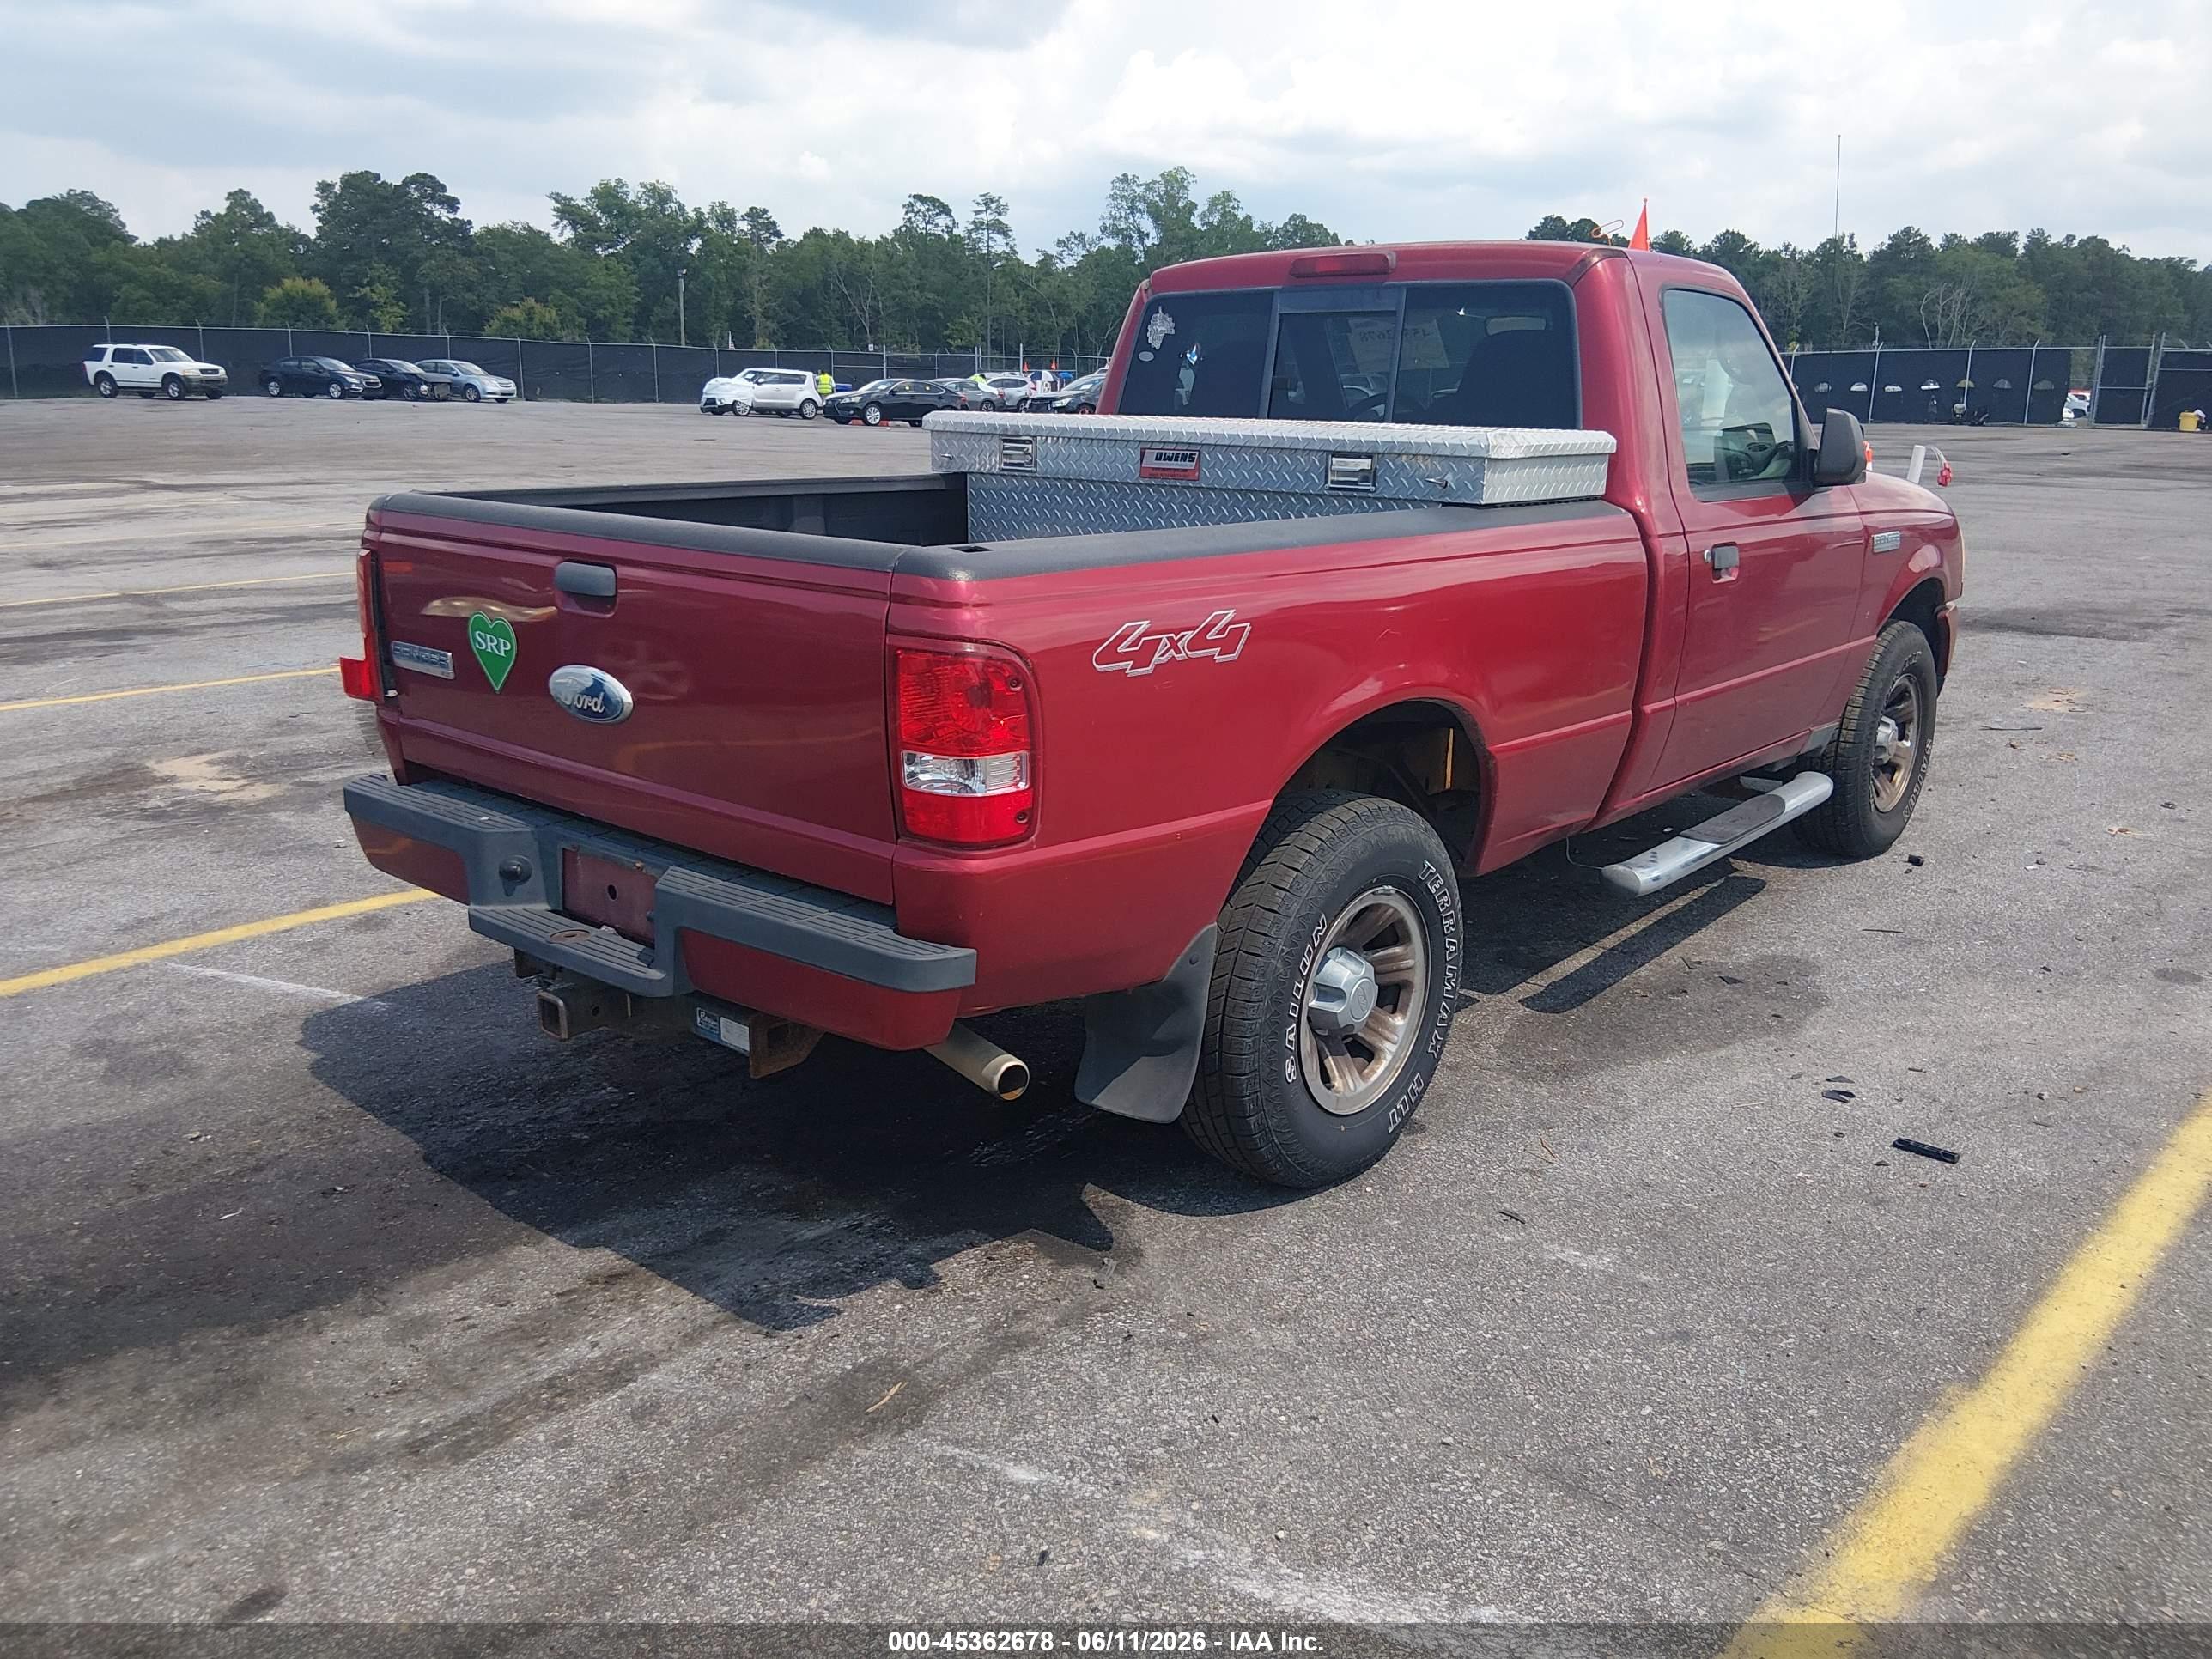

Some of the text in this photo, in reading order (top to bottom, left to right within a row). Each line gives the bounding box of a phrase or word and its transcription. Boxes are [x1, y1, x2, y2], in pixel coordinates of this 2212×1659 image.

[1154, 451, 1197, 463] OWENS
[475, 630, 512, 658] SRP
[1092, 608, 1252, 678] 4x4
[555, 676, 605, 714] Ford
[1418, 860, 1459, 1059] TERRAMAX
[1284, 914, 1328, 1084] SAILUN
